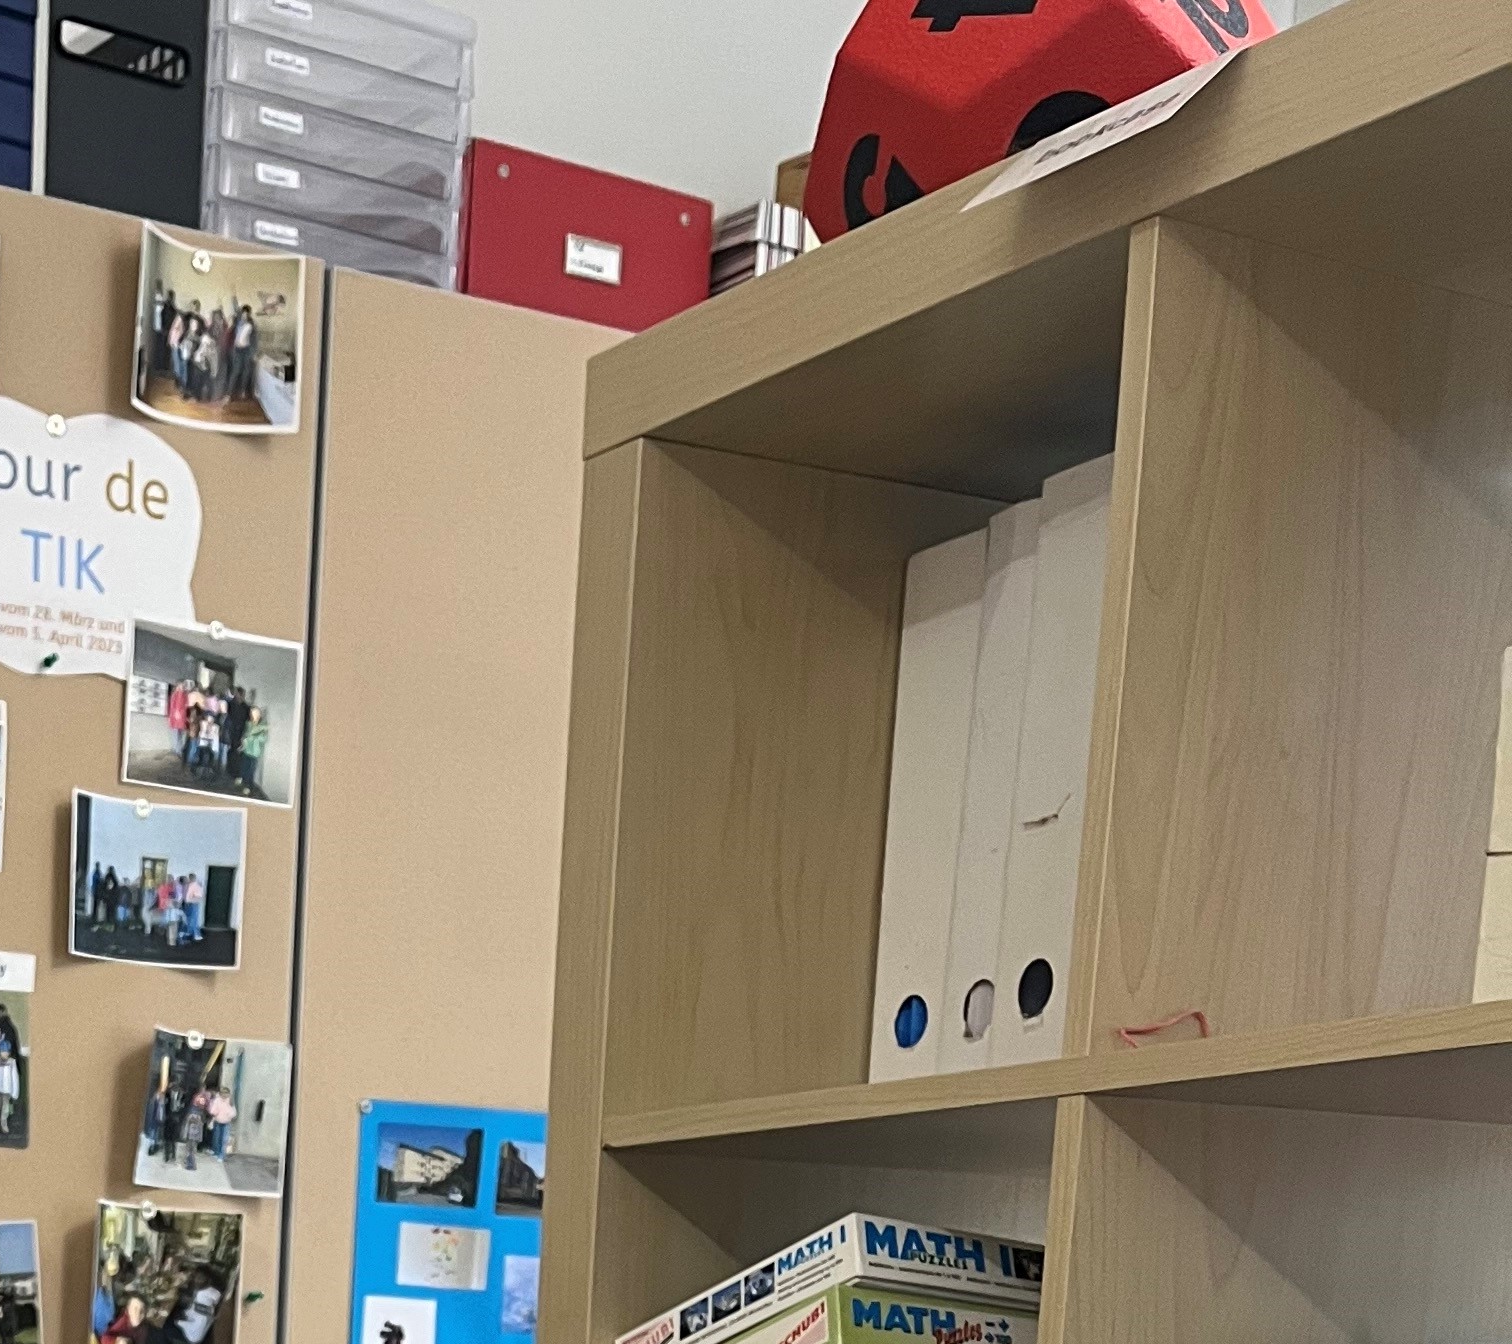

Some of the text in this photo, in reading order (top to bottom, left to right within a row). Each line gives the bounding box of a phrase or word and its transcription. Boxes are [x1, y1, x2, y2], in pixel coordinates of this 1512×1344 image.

[105, 458, 170, 520] de
[20, 527, 106, 595] TIK
[777, 1231, 833, 1276] MATH
[864, 1220, 987, 1273] MATH
[851, 1298, 957, 1335] MATH
